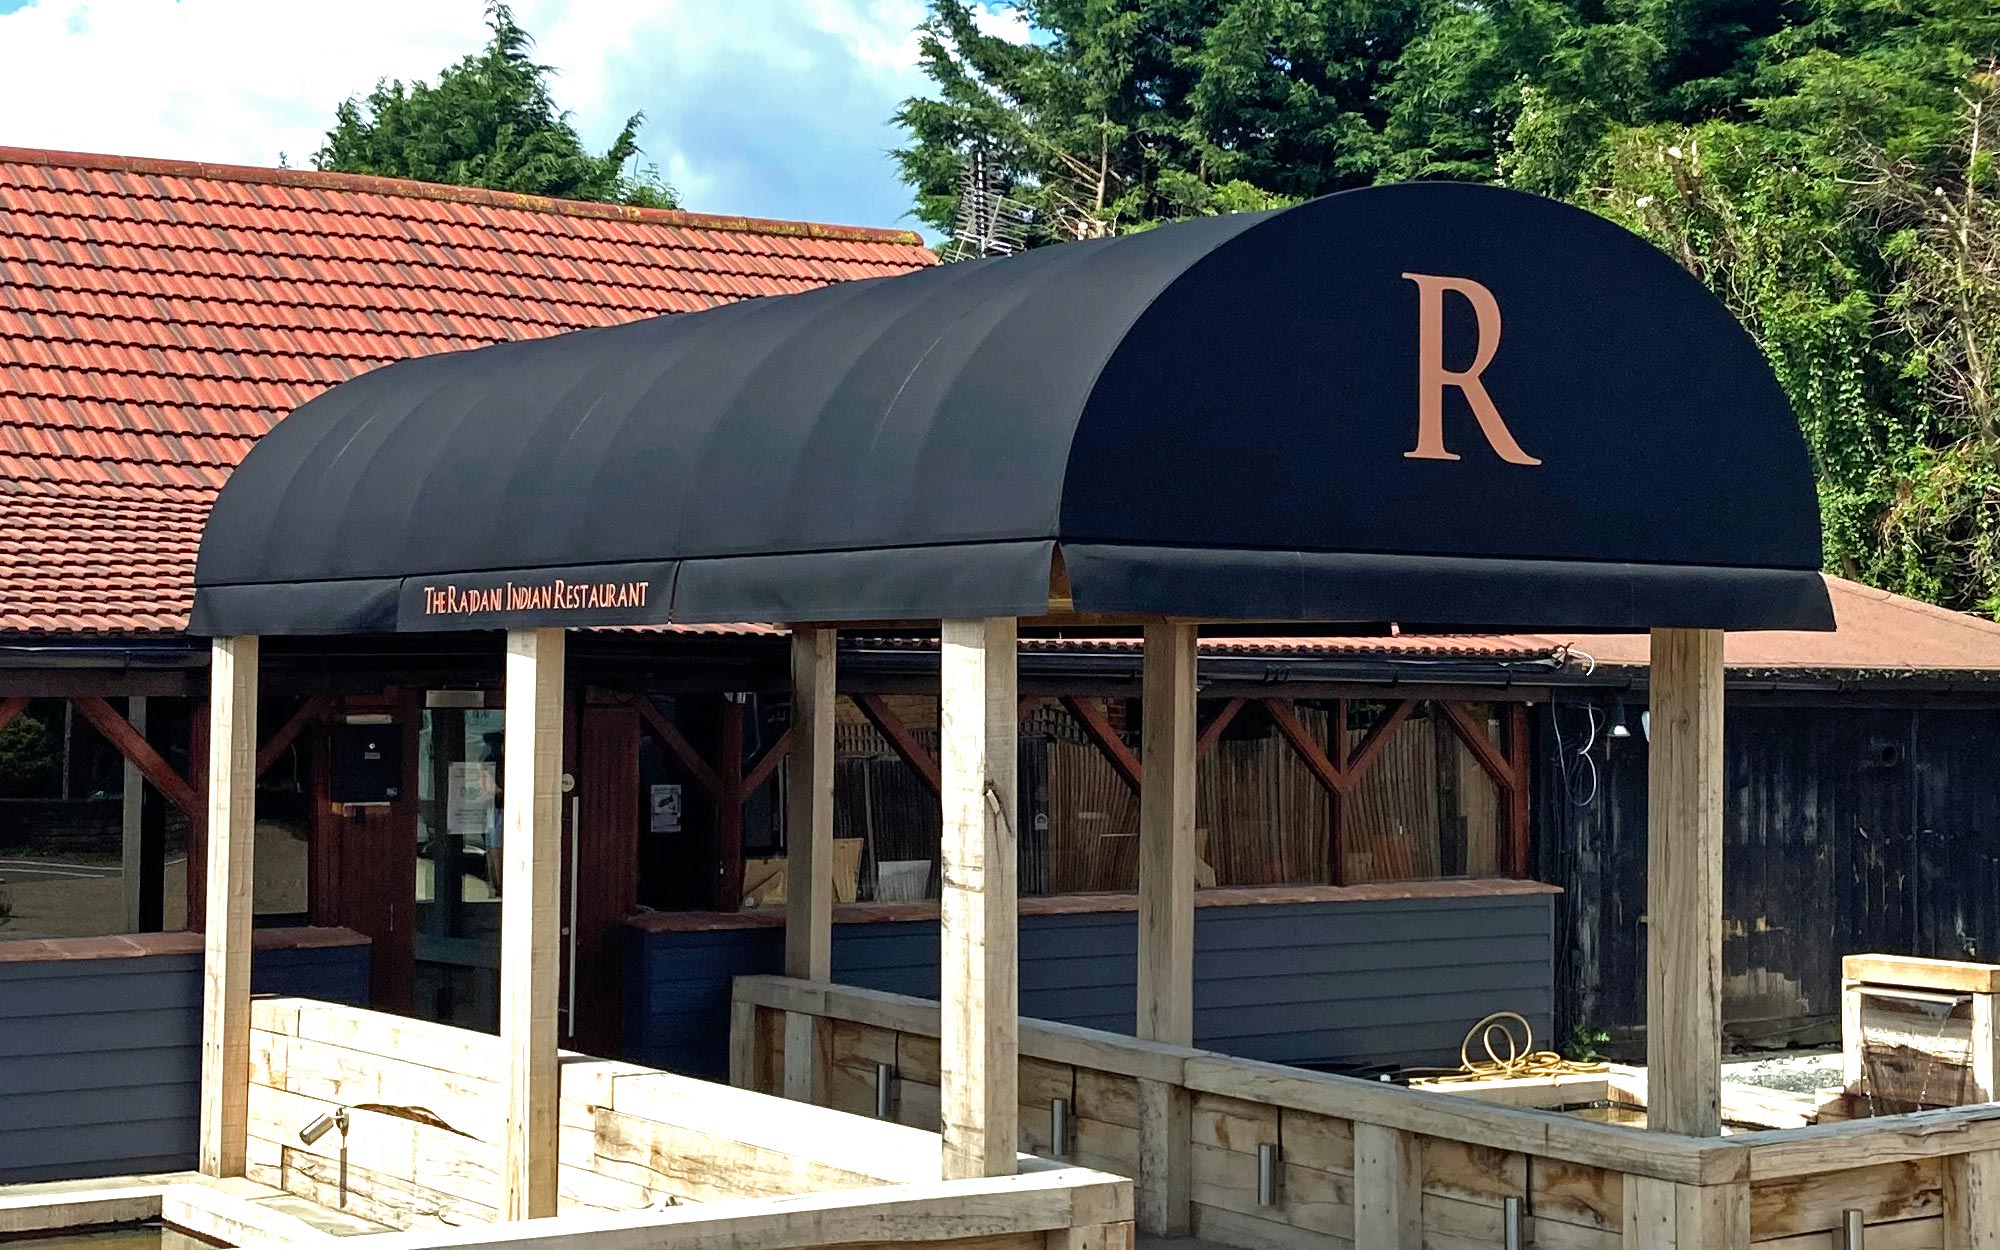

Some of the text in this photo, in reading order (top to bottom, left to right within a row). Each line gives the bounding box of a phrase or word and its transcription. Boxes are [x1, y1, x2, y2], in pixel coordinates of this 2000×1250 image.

[1401, 272, 1542, 466] R
[424, 579, 649, 616] THE RAJDANI INDIAN RESTAURANT
